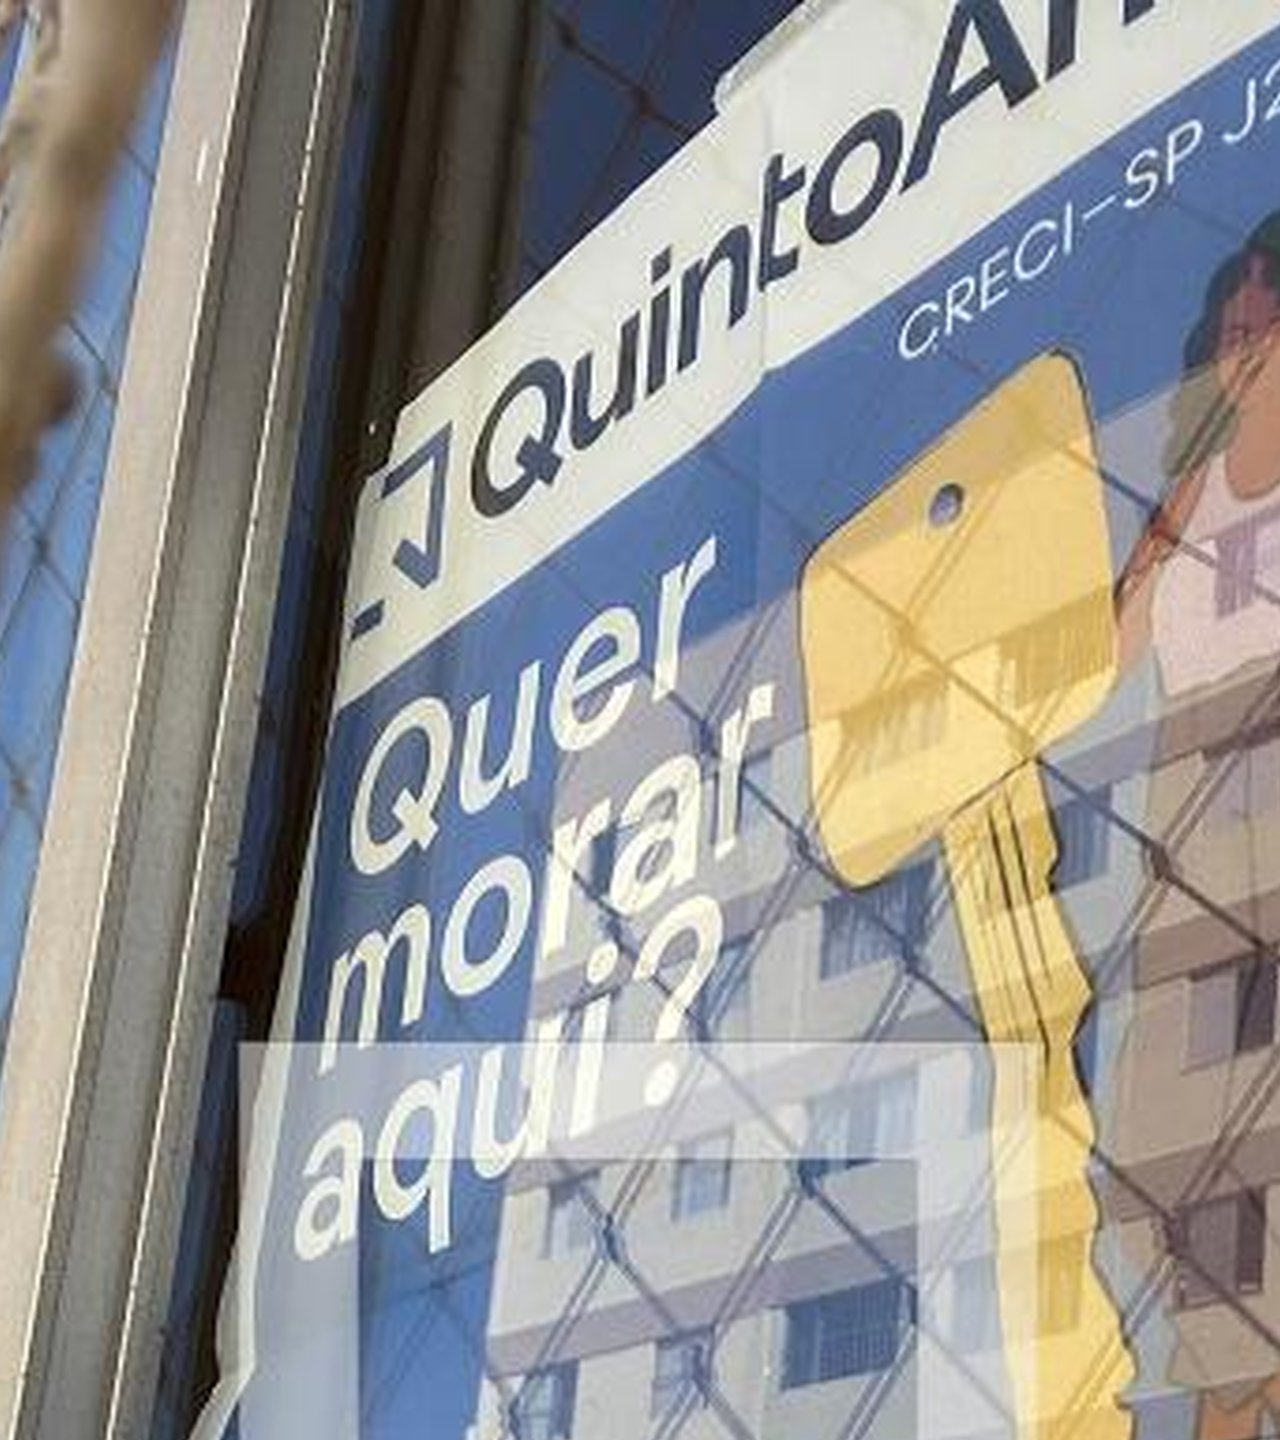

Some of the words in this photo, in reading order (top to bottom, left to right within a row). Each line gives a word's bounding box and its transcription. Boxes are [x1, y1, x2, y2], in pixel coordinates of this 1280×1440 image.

[320, 683, 775, 1076] morar
[350, 535, 716, 876] Quer
[293, 894, 724, 1262] aqui?
